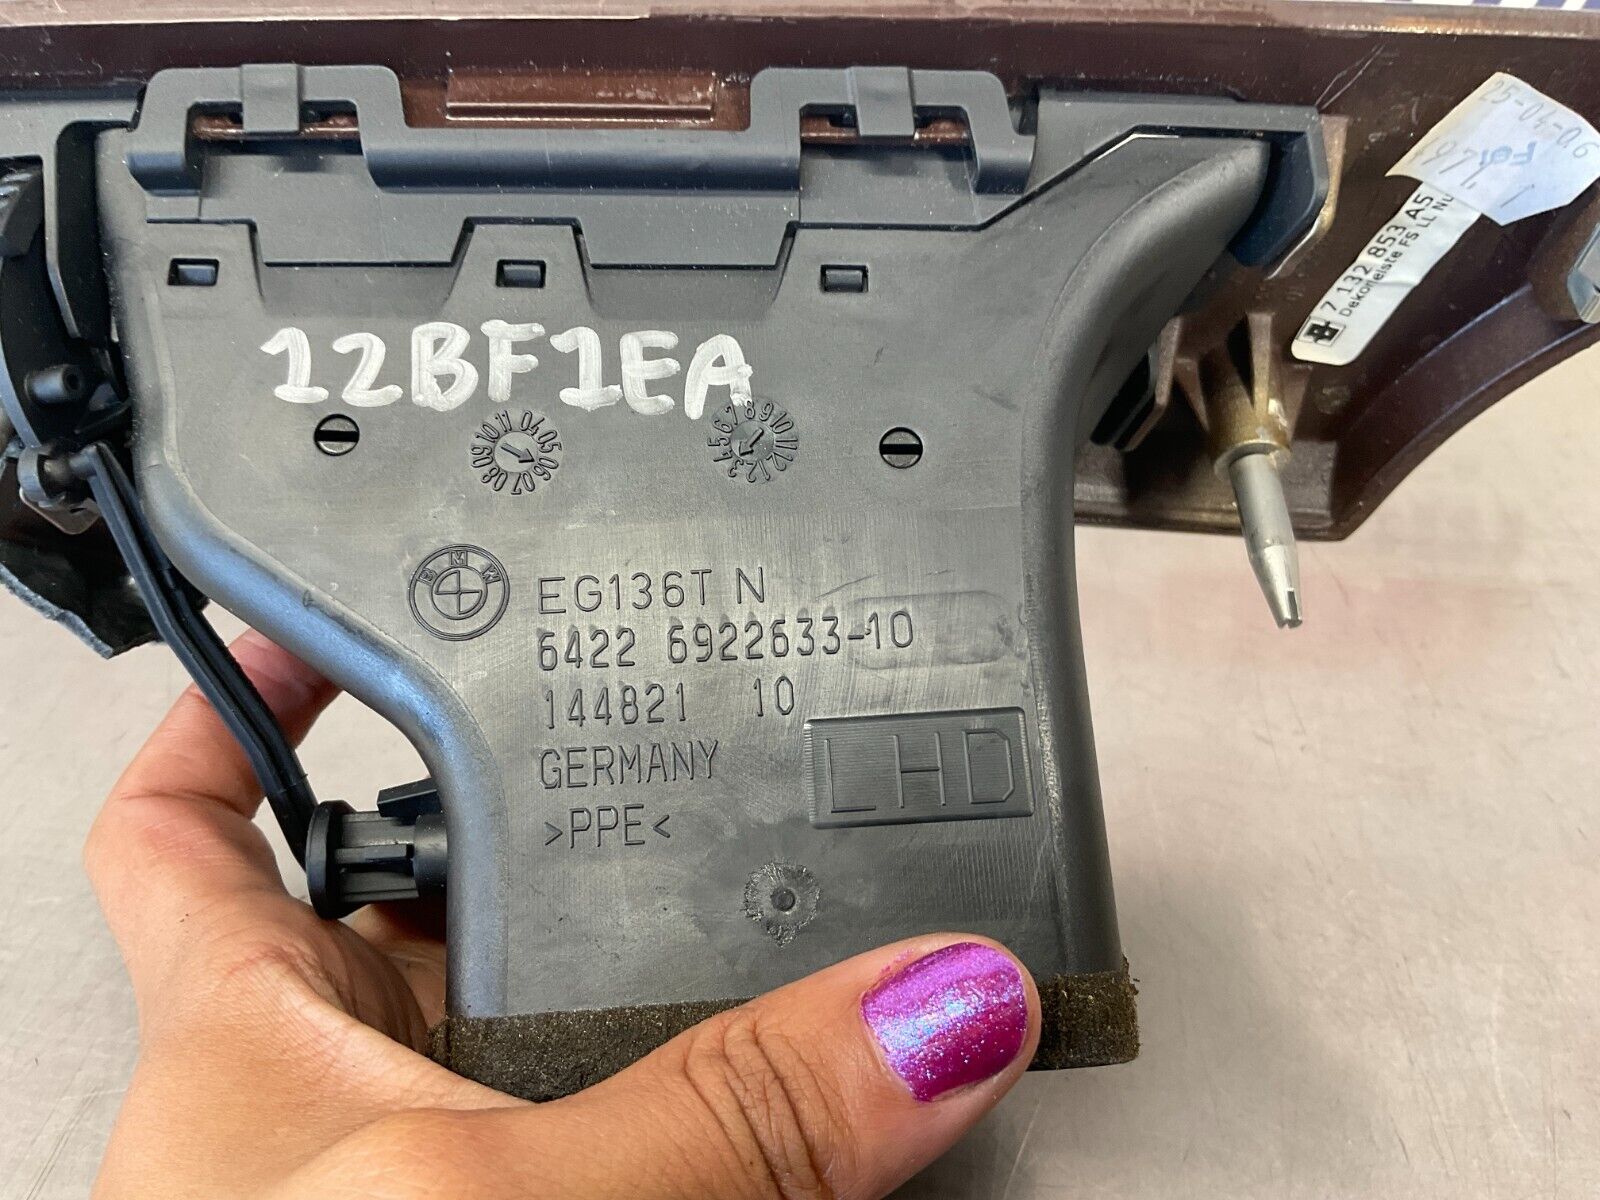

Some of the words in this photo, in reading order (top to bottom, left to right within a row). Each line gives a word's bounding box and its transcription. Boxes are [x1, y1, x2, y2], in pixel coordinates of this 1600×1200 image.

[1320, 300, 1338, 311] 7
[1336, 265, 1372, 293] 132
[1367, 225, 1407, 258] 853
[1405, 194, 1434, 220] A5
[1339, 250, 1403, 318] Dekorleiste
[1399, 231, 1420, 247] FS
[1417, 215, 1438, 228] LL
[260, 319, 753, 420] 12BF1EA
[474, 422, 501, 444] 10
[520, 409, 546, 437] 04
[537, 429, 563, 454] 05
[510, 470, 536, 496] 07
[532, 456, 560, 482] 06
[415, 549, 502, 587] BMW
[538, 568, 712, 615] EG136T
[735, 566, 767, 604] N
[538, 627, 637, 671] 6422
[666, 609, 914, 664] 6922633-10
[544, 682, 688, 730] 144821
[752, 675, 796, 718] 10
[538, 740, 720, 790] GERMANY
[824, 727, 1016, 814] LHD
[544, 802, 672, 850] >PPE<
